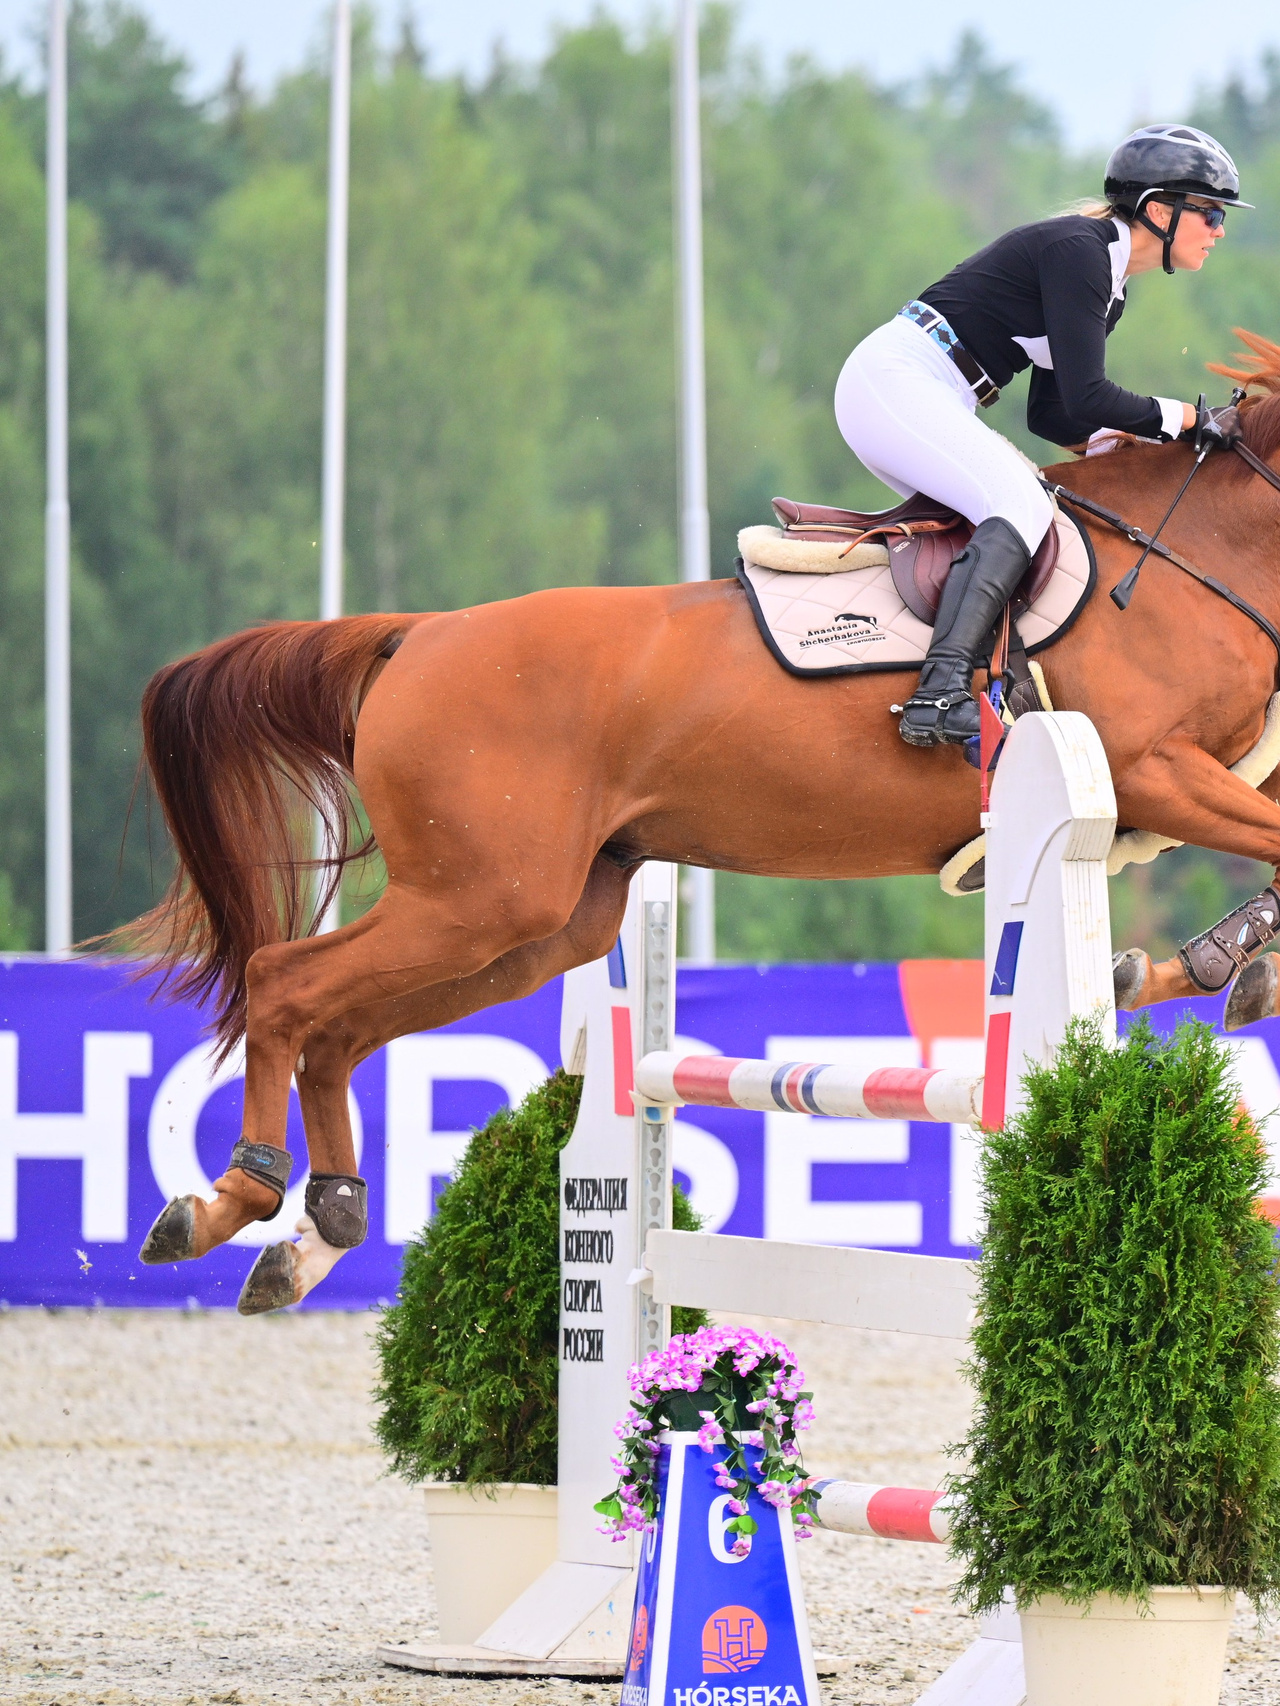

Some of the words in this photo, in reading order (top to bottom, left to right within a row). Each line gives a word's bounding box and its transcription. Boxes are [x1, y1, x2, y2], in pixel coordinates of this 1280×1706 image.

[799, 629, 871, 647] Shcherbakova
[807, 623, 858, 637] Anastasia
[564, 1178, 628, 1218] ФЕДЕРАЦИЯ
[564, 1230, 614, 1264] КОННОГО
[564, 1279, 603, 1313] СПОРТА
[563, 1328, 604, 1362] РОССИИ
[708, 1494, 752, 1564] 6
[673, 1681, 802, 1706] HÓRSEKA
